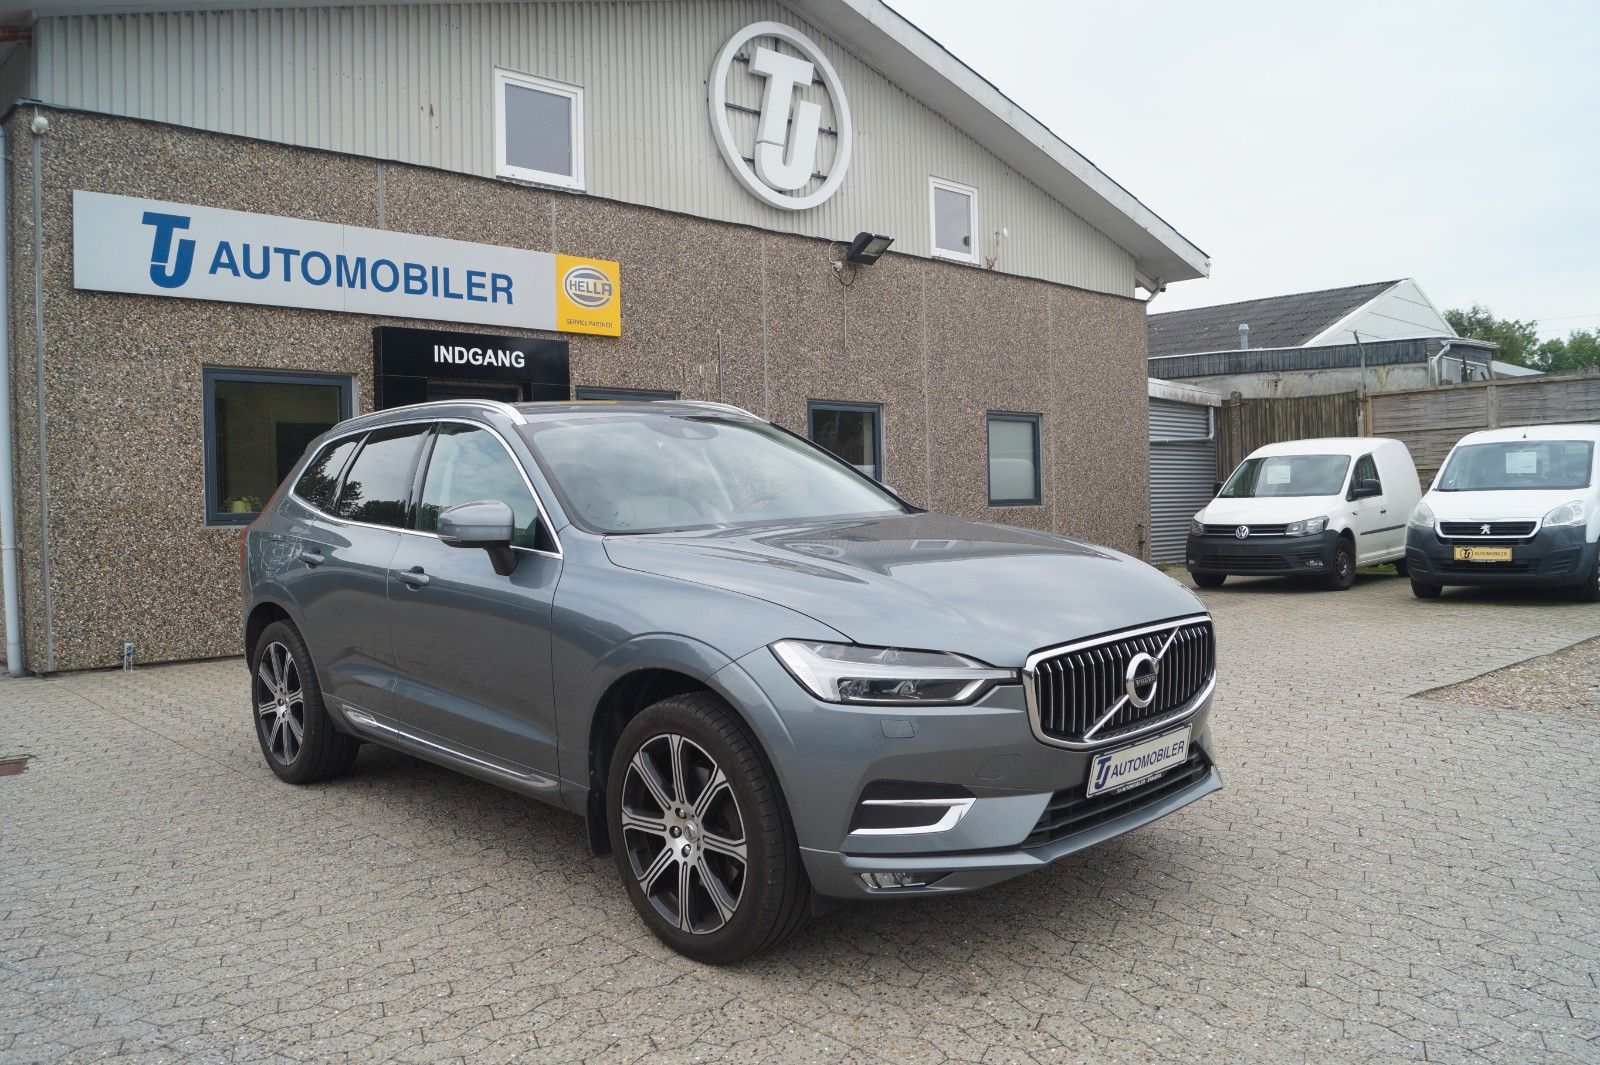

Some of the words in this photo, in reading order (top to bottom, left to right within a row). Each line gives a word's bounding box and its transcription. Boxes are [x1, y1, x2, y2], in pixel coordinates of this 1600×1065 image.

[748, 46, 815, 191] TJ
[141, 211, 196, 288] TJ
[209, 240, 514, 305] AUTOMOBILER
[569, 280, 612, 296] HELLA
[566, 319, 588, 327] SERVICE
[589, 321, 613, 329] PARTNER
[434, 345, 525, 368] INDGANG
[1135, 675, 1156, 686] VOLVO
[1094, 756, 1112, 789] TJ
[1111, 741, 1185, 778] AUTOMOBILER
